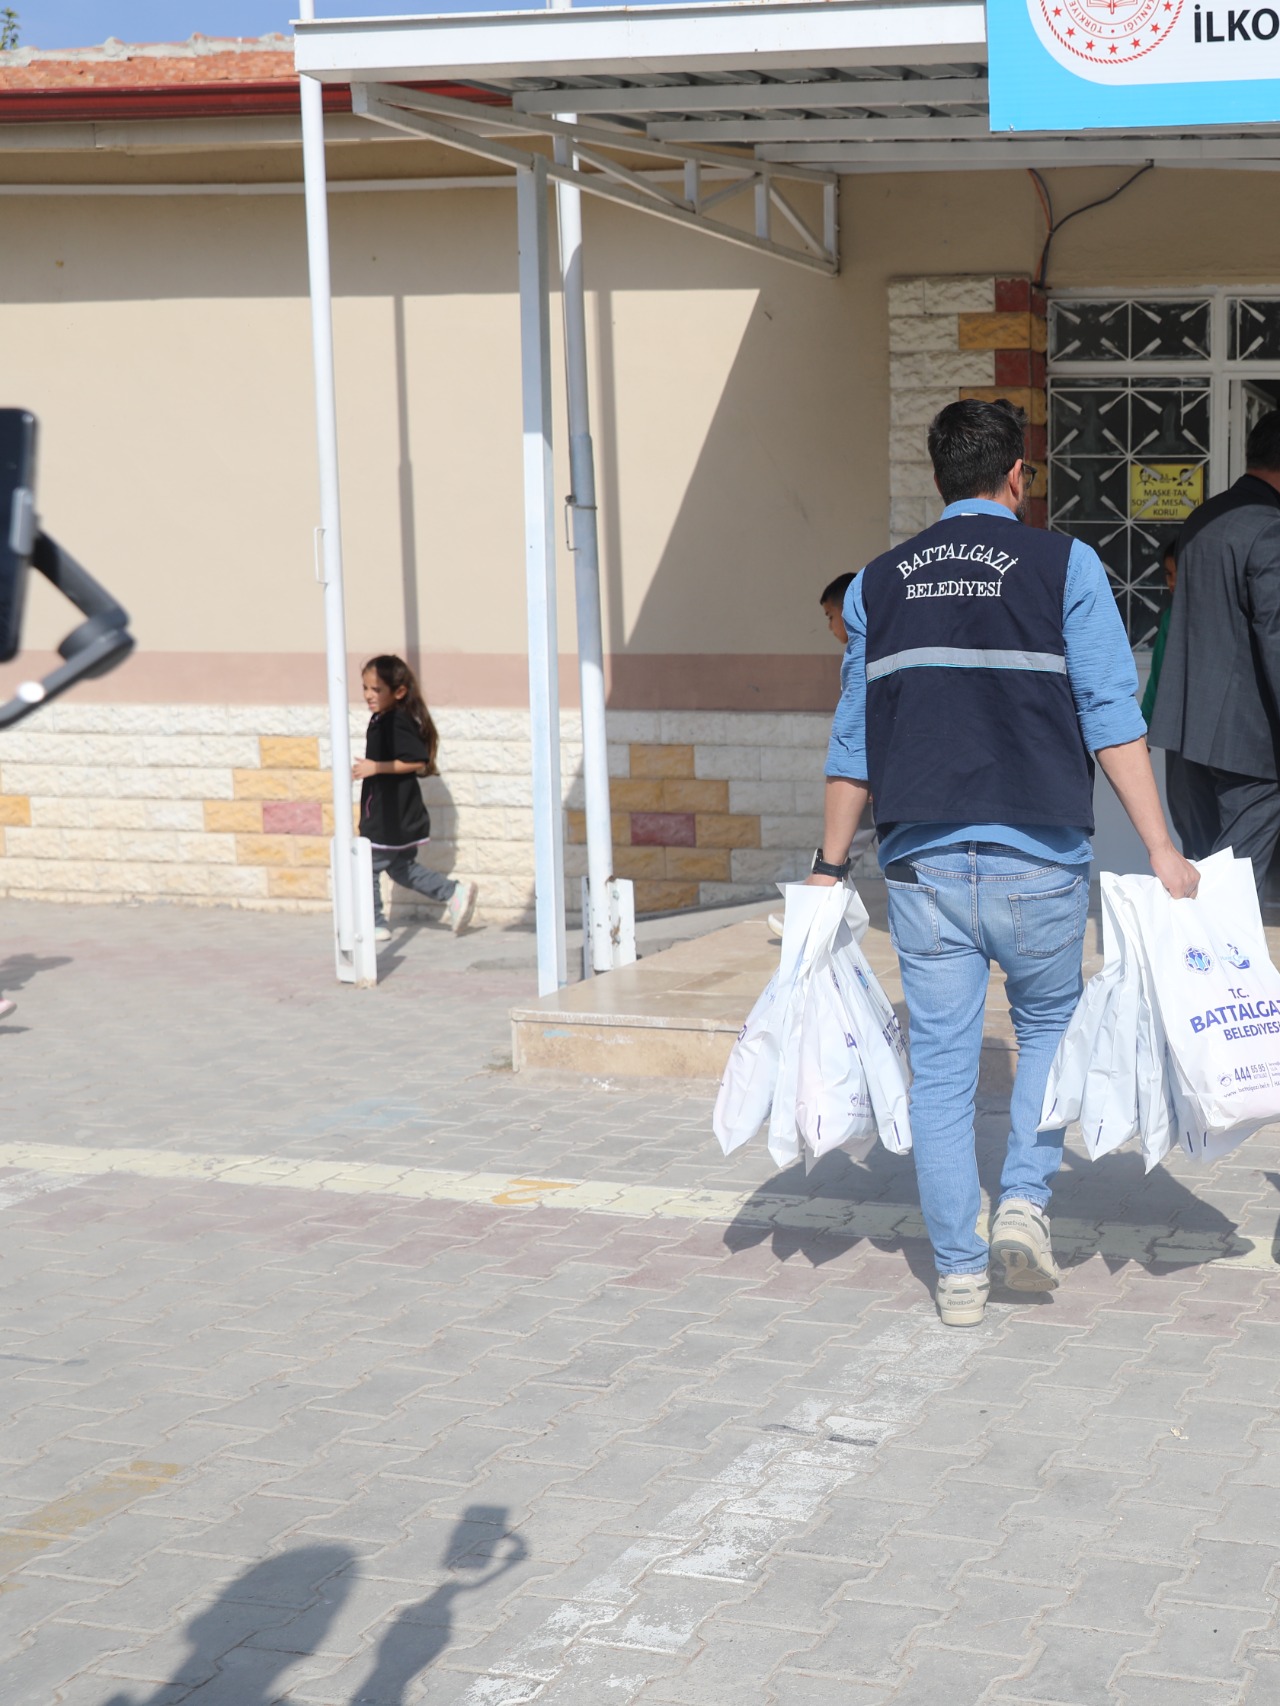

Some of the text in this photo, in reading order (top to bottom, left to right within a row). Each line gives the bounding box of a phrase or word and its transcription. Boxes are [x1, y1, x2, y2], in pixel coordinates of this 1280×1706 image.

[1143, 489, 1171, 497] MASKE
[1152, 508, 1178, 516] KORU!
[896, 543, 1019, 580] BATTALGAZİ
[905, 577, 1003, 600] BELEDİYESİ
[1228, 987, 1250, 999] T.C.
[1234, 1065, 1252, 1082] 444
